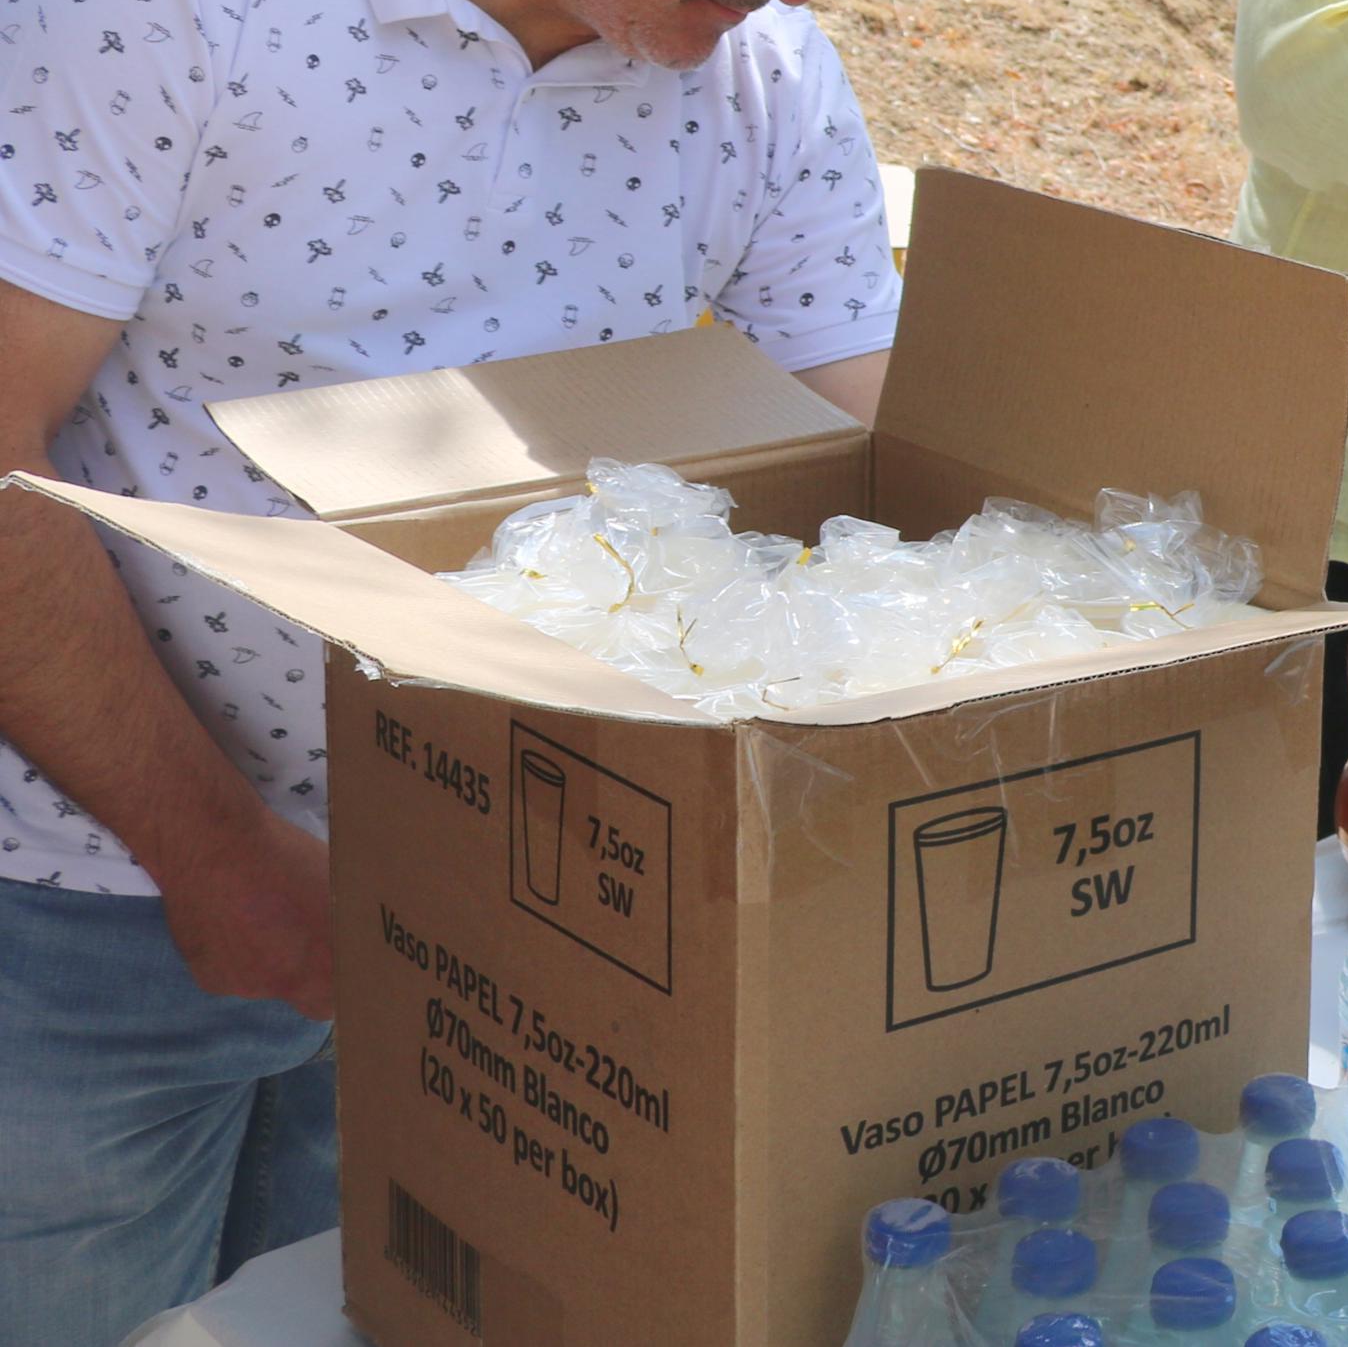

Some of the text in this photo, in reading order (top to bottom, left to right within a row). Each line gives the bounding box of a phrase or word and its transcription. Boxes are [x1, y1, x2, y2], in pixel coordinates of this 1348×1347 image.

[375, 709, 491, 815] REF. 14435
[587, 815, 645, 877] 7,5oz
[1053, 812, 1154, 867] 7,5oz
[1070, 865, 1136, 917] SW
[598, 872, 633, 919] SW
[381, 902, 669, 1133] Vaso PAPEL 7,5oz-220ml
[426, 997, 610, 1154] Ø70mm Blanco
[840, 1003, 1231, 1155] Vaso PAPEL 7,5oz-220ml
[420, 1046, 619, 1233] (20 x 50 per box)
[917, 1115, 1051, 1185] Ø70mm
[1060, 1079, 1165, 1135] Blanco
